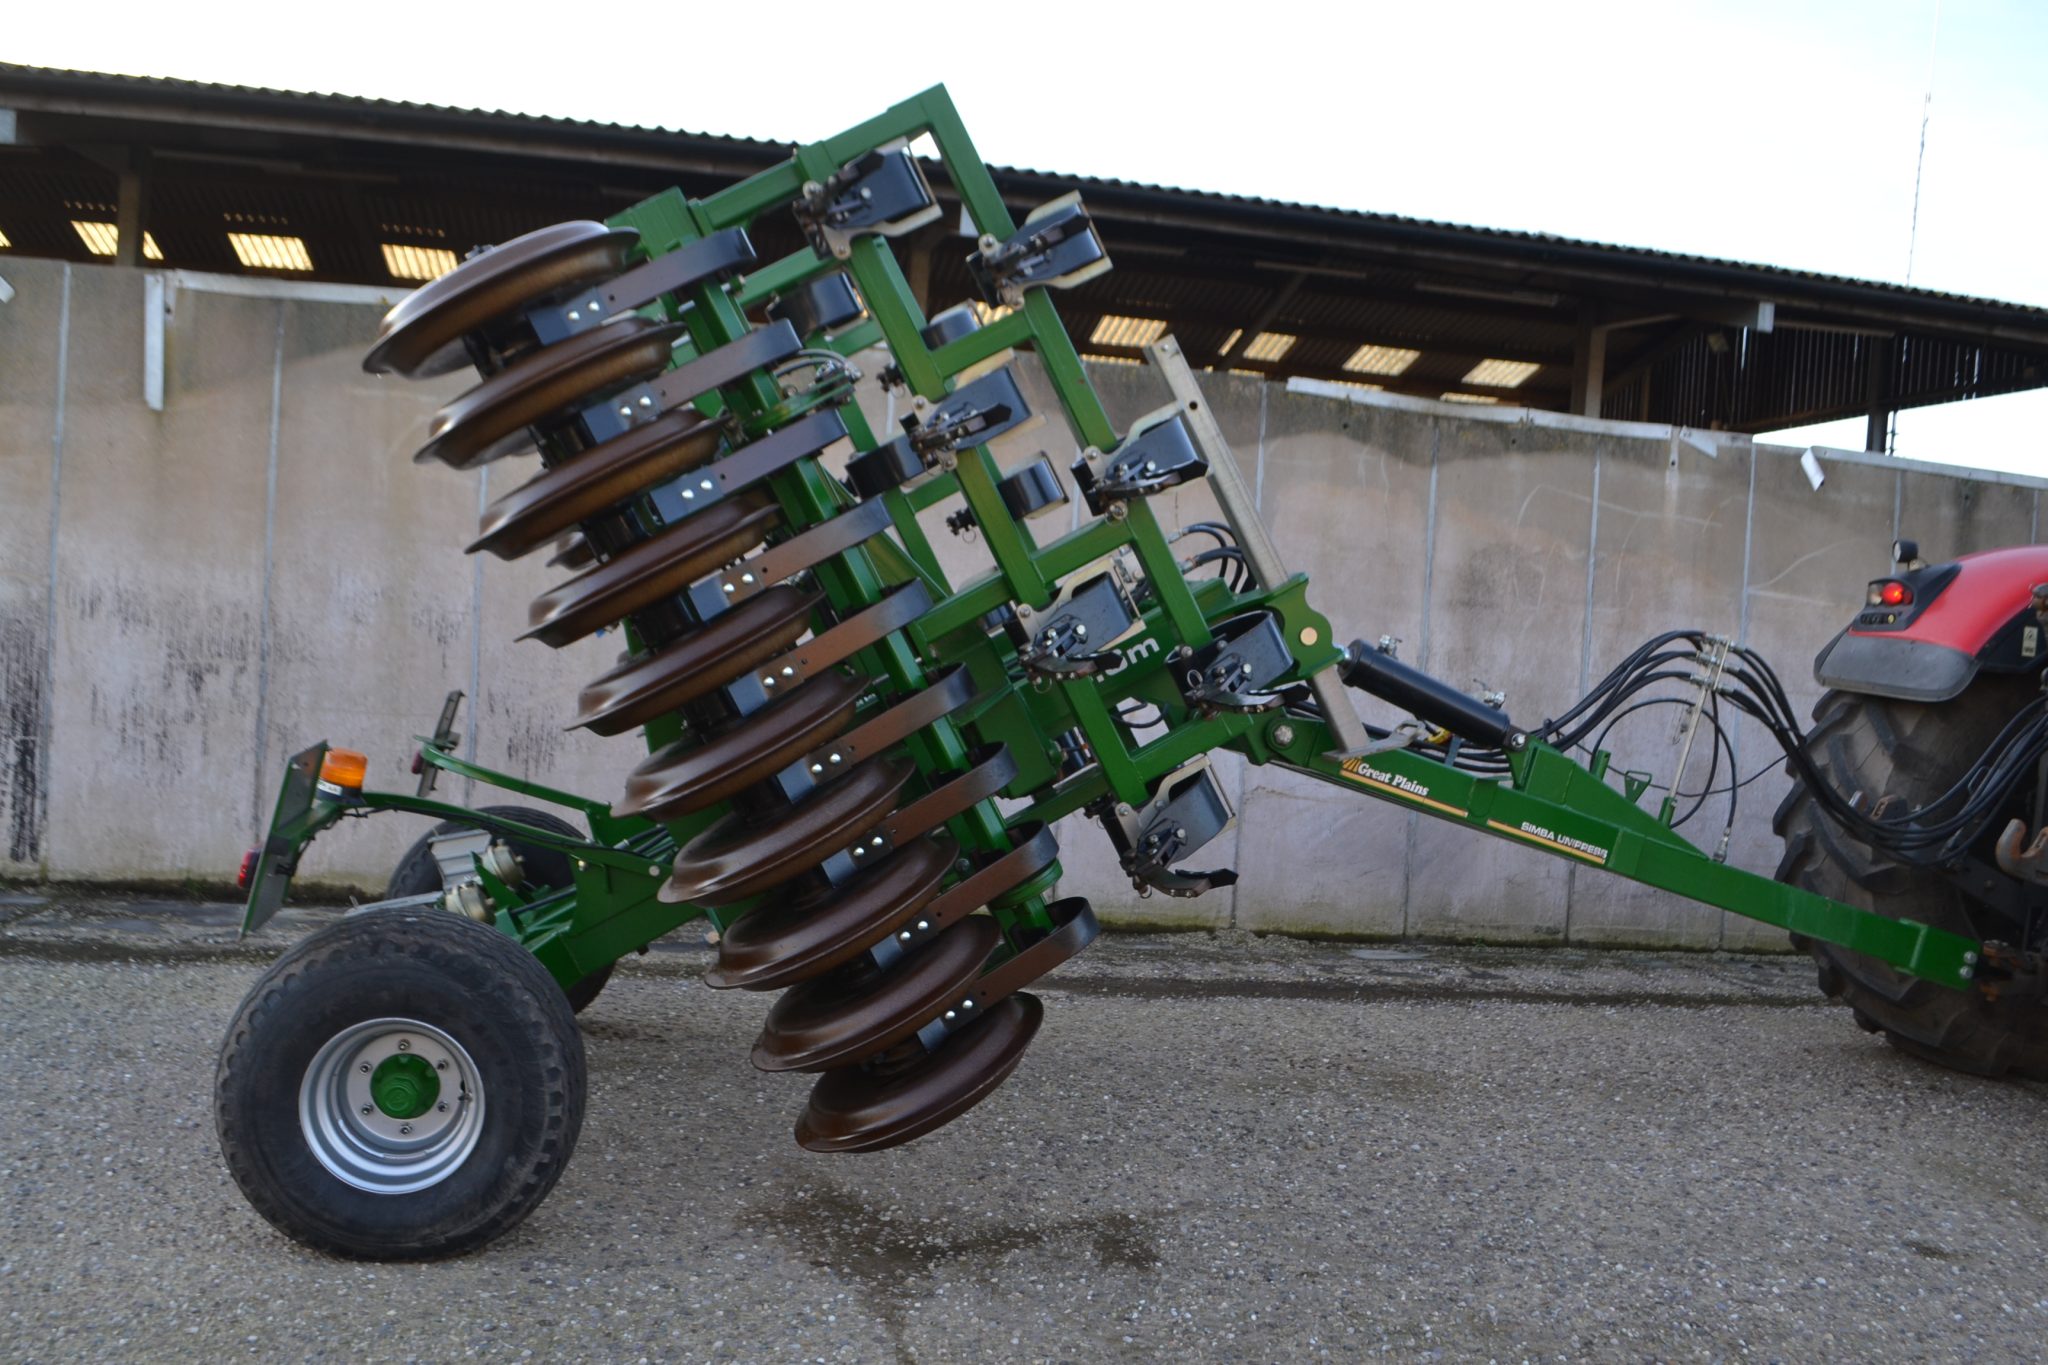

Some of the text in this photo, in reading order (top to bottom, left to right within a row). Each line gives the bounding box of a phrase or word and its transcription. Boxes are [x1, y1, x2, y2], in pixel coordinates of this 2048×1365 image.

[1358, 762, 1430, 796] Great Plains
[1521, 821, 1555, 841] SIMBA
